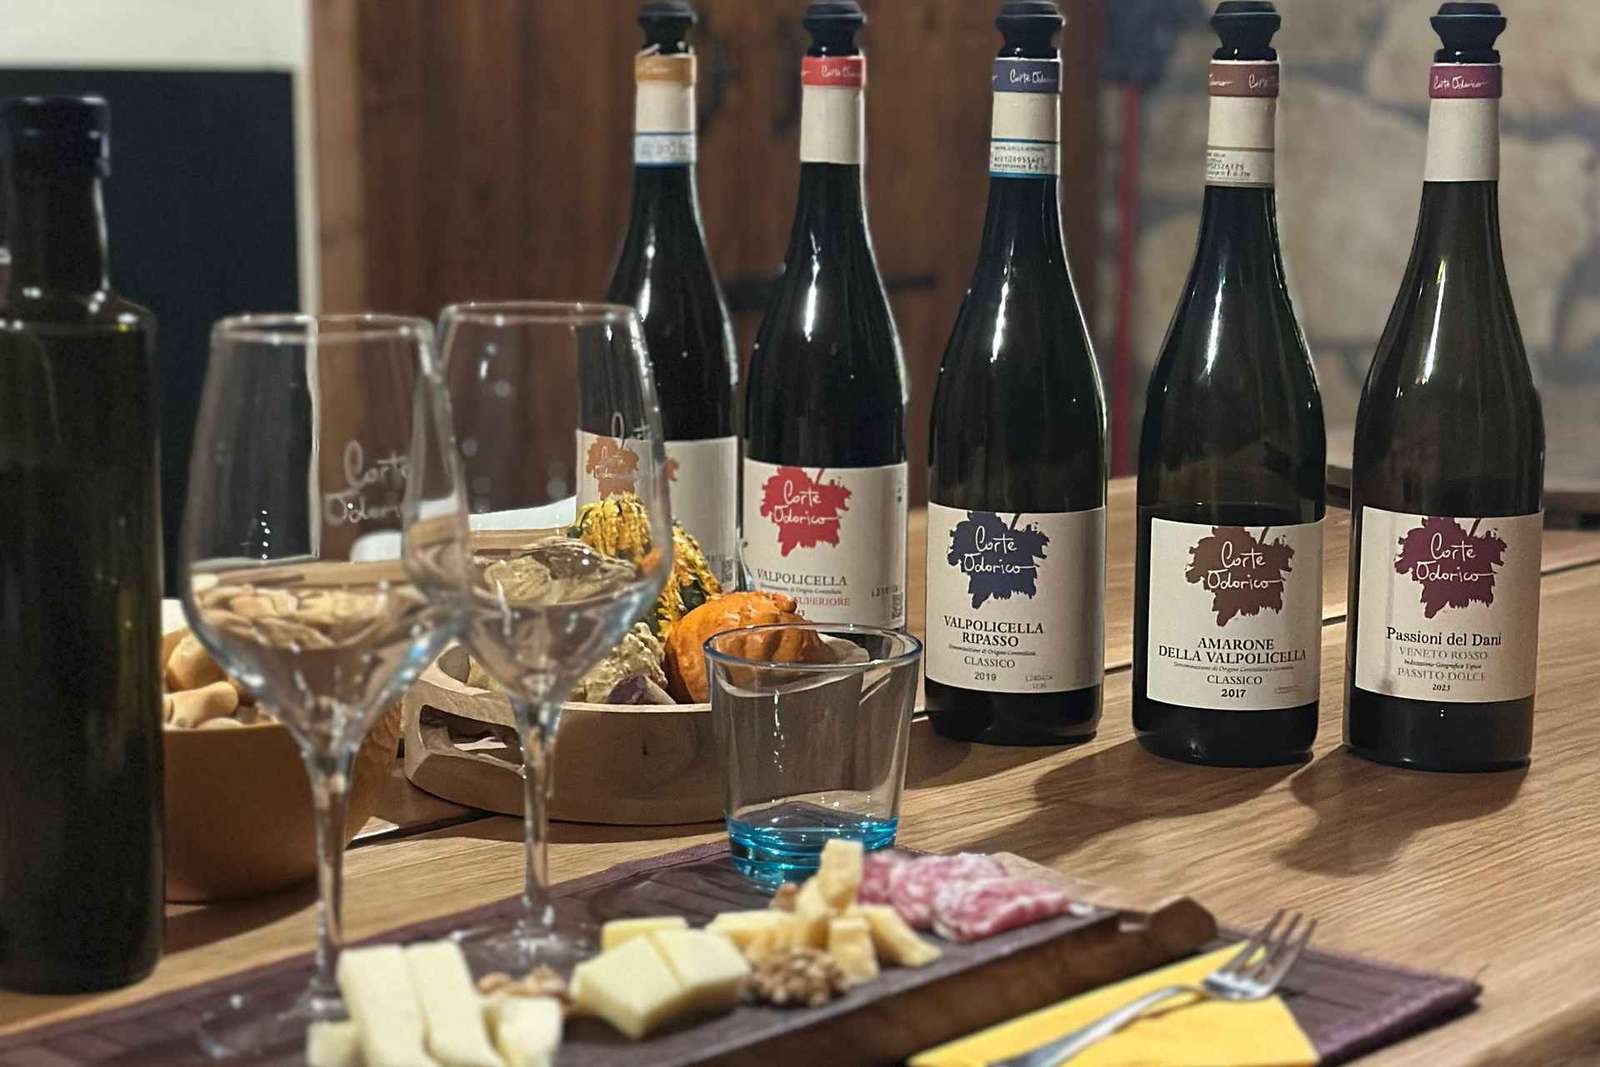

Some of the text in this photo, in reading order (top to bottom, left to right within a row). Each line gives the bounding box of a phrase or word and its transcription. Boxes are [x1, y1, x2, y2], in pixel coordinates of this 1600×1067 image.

[783, 479, 822, 507] Corte
[773, 504, 842, 526] Odorico
[975, 525, 1017, 555] Corte
[1430, 532, 1477, 562] Corte
[963, 552, 1037, 575] Odorico
[1221, 540, 1266, 570] Corte
[757, 568, 848, 587] VALPOLICELLA
[1207, 568, 1283, 591] Odorico
[1416, 560, 1495, 583] Odorico
[944, 615, 1044, 634] VALPOLICELLA
[962, 632, 1019, 647] RIPASSO
[1198, 637, 1275, 651] AMARONE
[1386, 626, 1502, 647] Passioni del Dani
[964, 655, 1016, 669] CLASSICO
[1159, 645, 1200, 662] DELLA
[1206, 649, 1307, 665] VALPOLICELLA
[1400, 646, 1489, 661] VENETO ROSSO
[974, 672, 997, 682] 2019
[1207, 675, 1263, 686] CLASSICO
[1398, 667, 1445, 681] PASSITO
[1221, 689, 1247, 698] 2017
